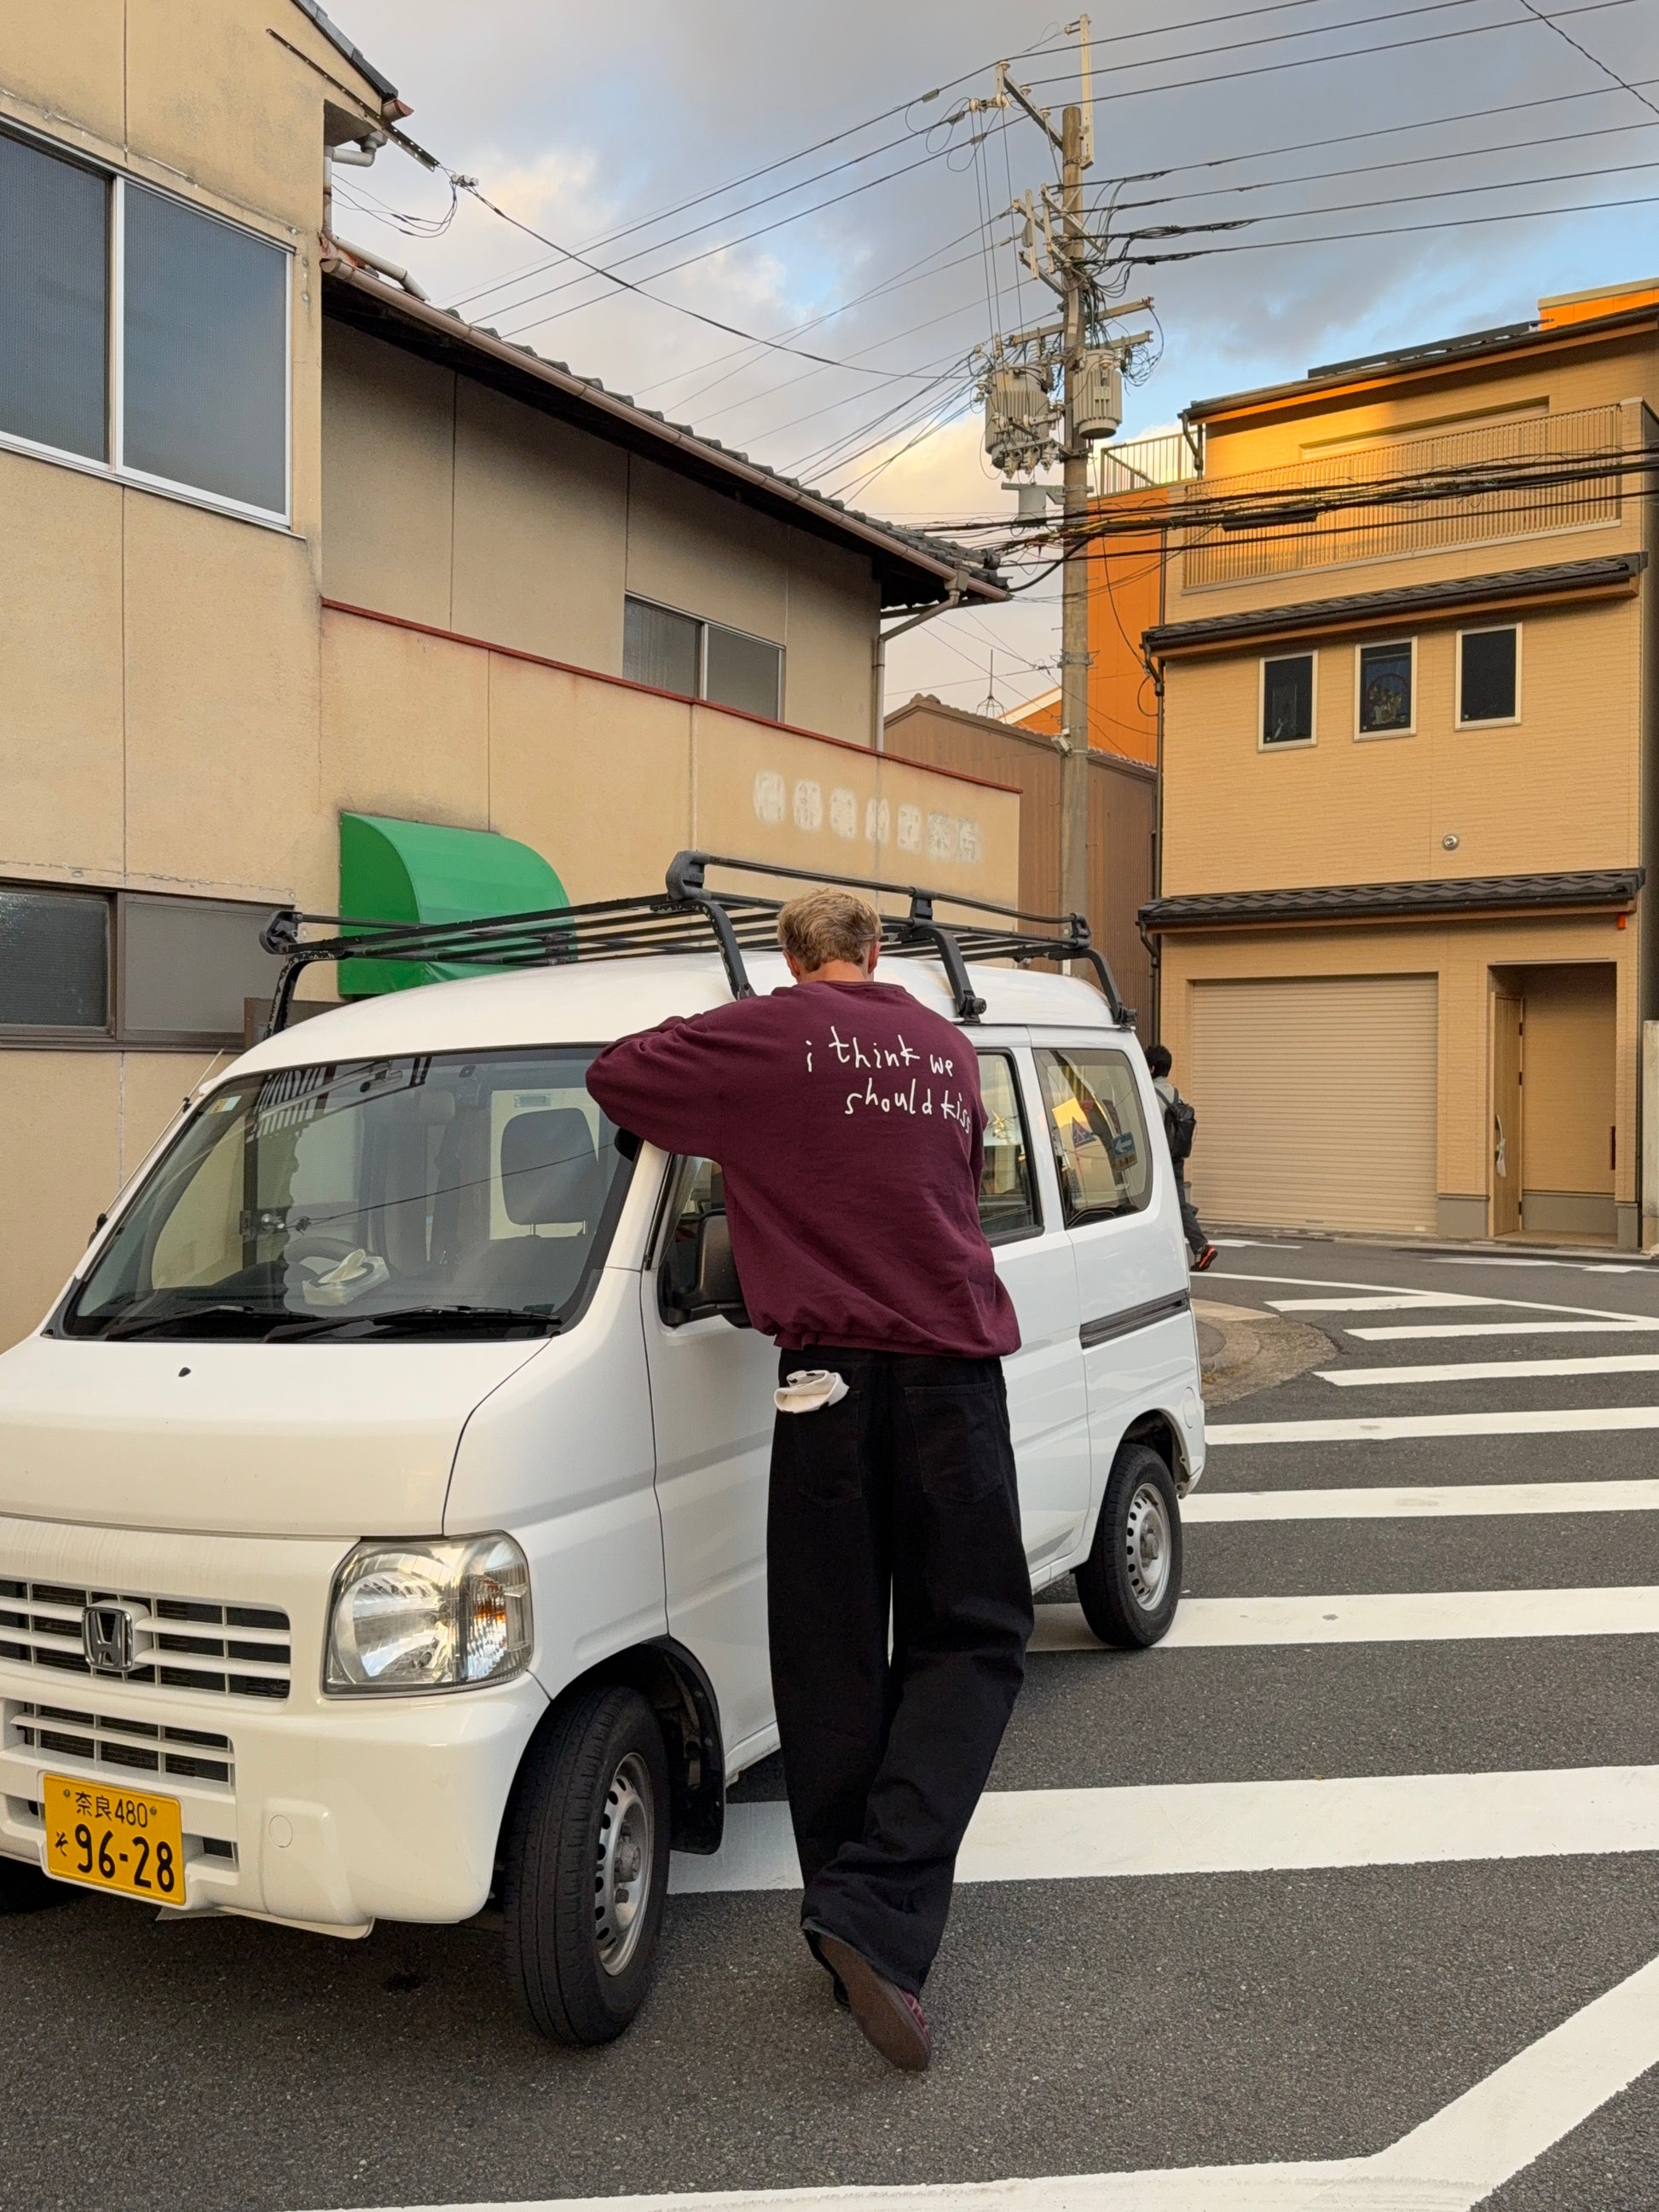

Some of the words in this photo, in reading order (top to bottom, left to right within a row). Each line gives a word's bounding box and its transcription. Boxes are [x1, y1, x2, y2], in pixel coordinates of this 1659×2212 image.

[805, 1040, 812, 1072] i
[829, 1025, 921, 1069] think
[929, 1054, 953, 1077] we
[845, 1078, 933, 1115] should
[941, 1090, 971, 1134] kiss
[55, 1831, 69, 1857] そ
[75, 1824, 175, 1892] 96-28
